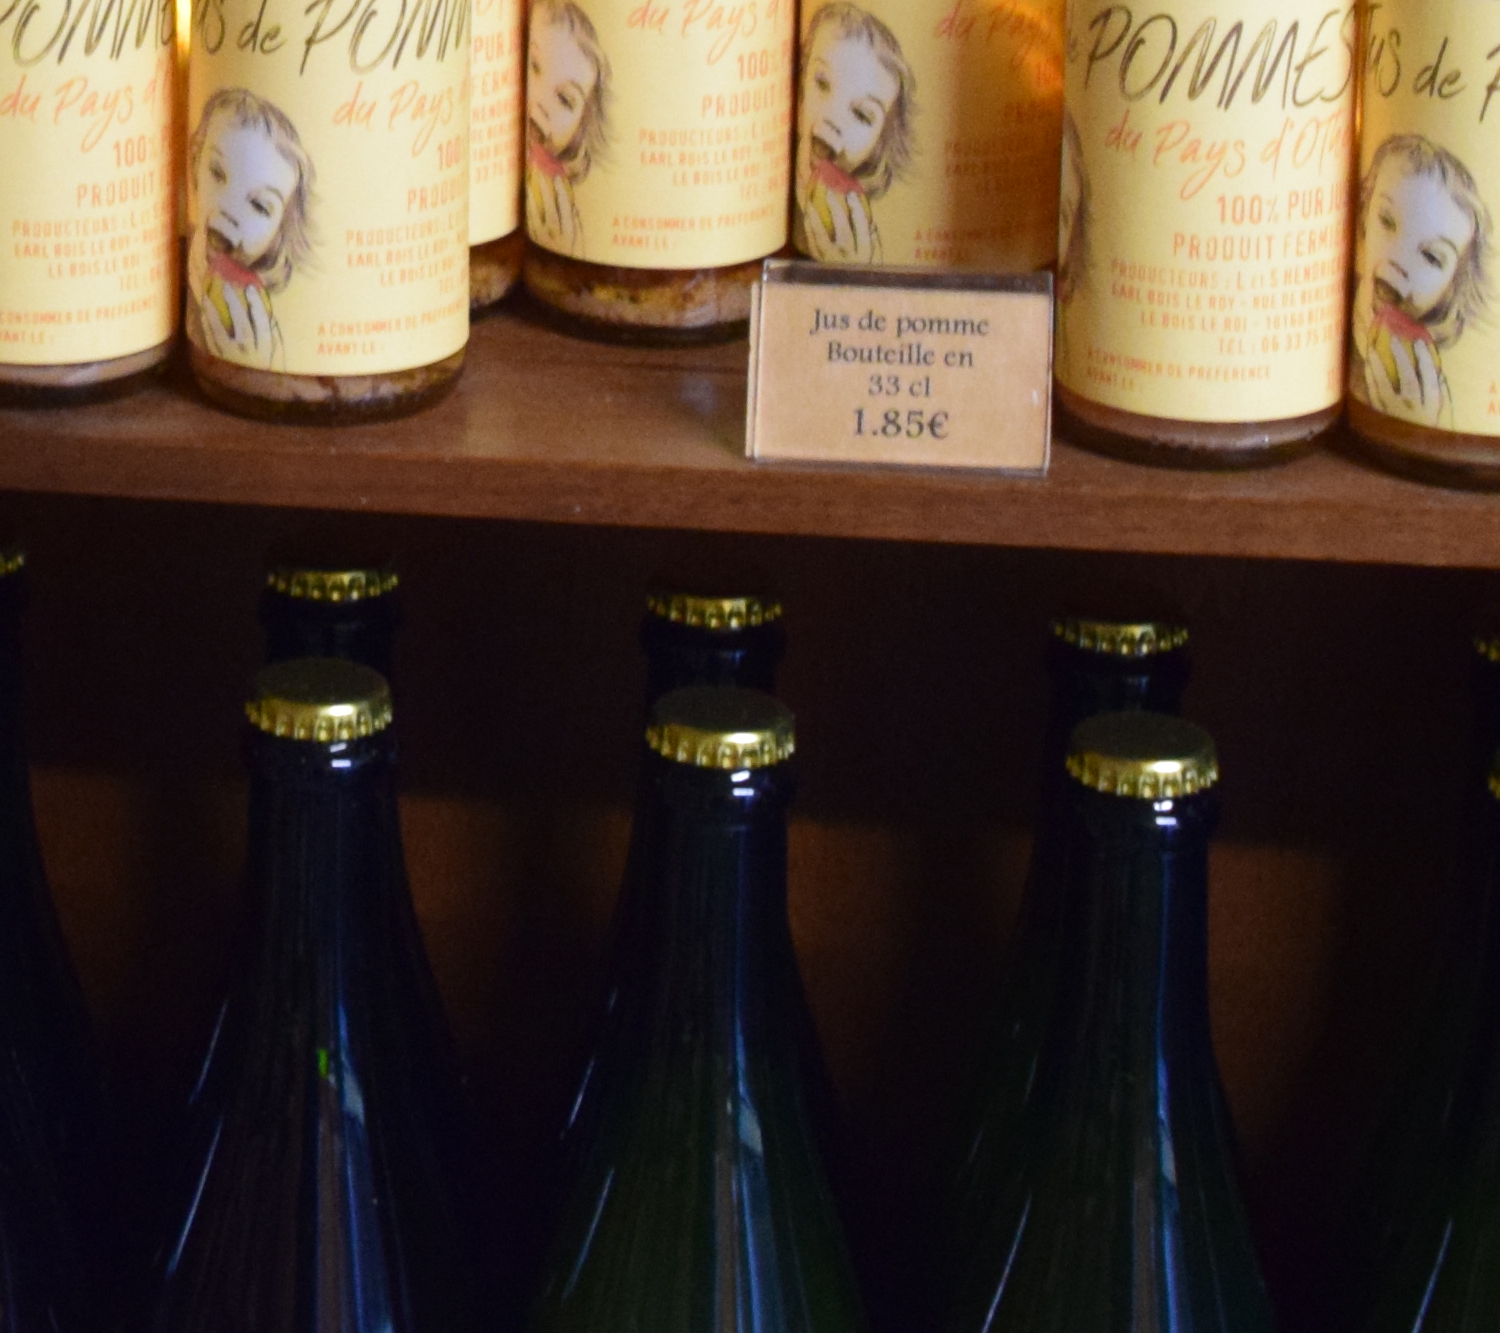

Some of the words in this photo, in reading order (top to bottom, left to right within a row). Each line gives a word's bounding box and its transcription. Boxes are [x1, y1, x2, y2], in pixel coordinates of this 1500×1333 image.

[1413, 36, 1467, 100] de
[54, 75, 133, 153] Pays
[701, 85, 776, 118] PRODUIT
[332, 81, 377, 127] du
[388, 80, 454, 158] Pays
[1104, 109, 1143, 153] du
[1153, 119, 1246, 201] Pays
[77, 171, 155, 208] PRODUIT
[1217, 194, 1280, 225] 100%
[1288, 188, 1324, 221] PUR
[1173, 232, 1274, 262] PRODUIT
[1148, 289, 1180, 309] BOIS
[1187, 295, 1201, 309] LE
[1208, 295, 1235, 310] ROY
[810, 309, 850, 334] Jus
[858, 310, 885, 331] de
[897, 314, 989, 337] pomme
[828, 341, 935, 366] Bouteille
[944, 350, 973, 367] en
[868, 374, 900, 396] 33
[909, 376, 931, 397] cl
[854, 408, 949, 439] 1.85€
